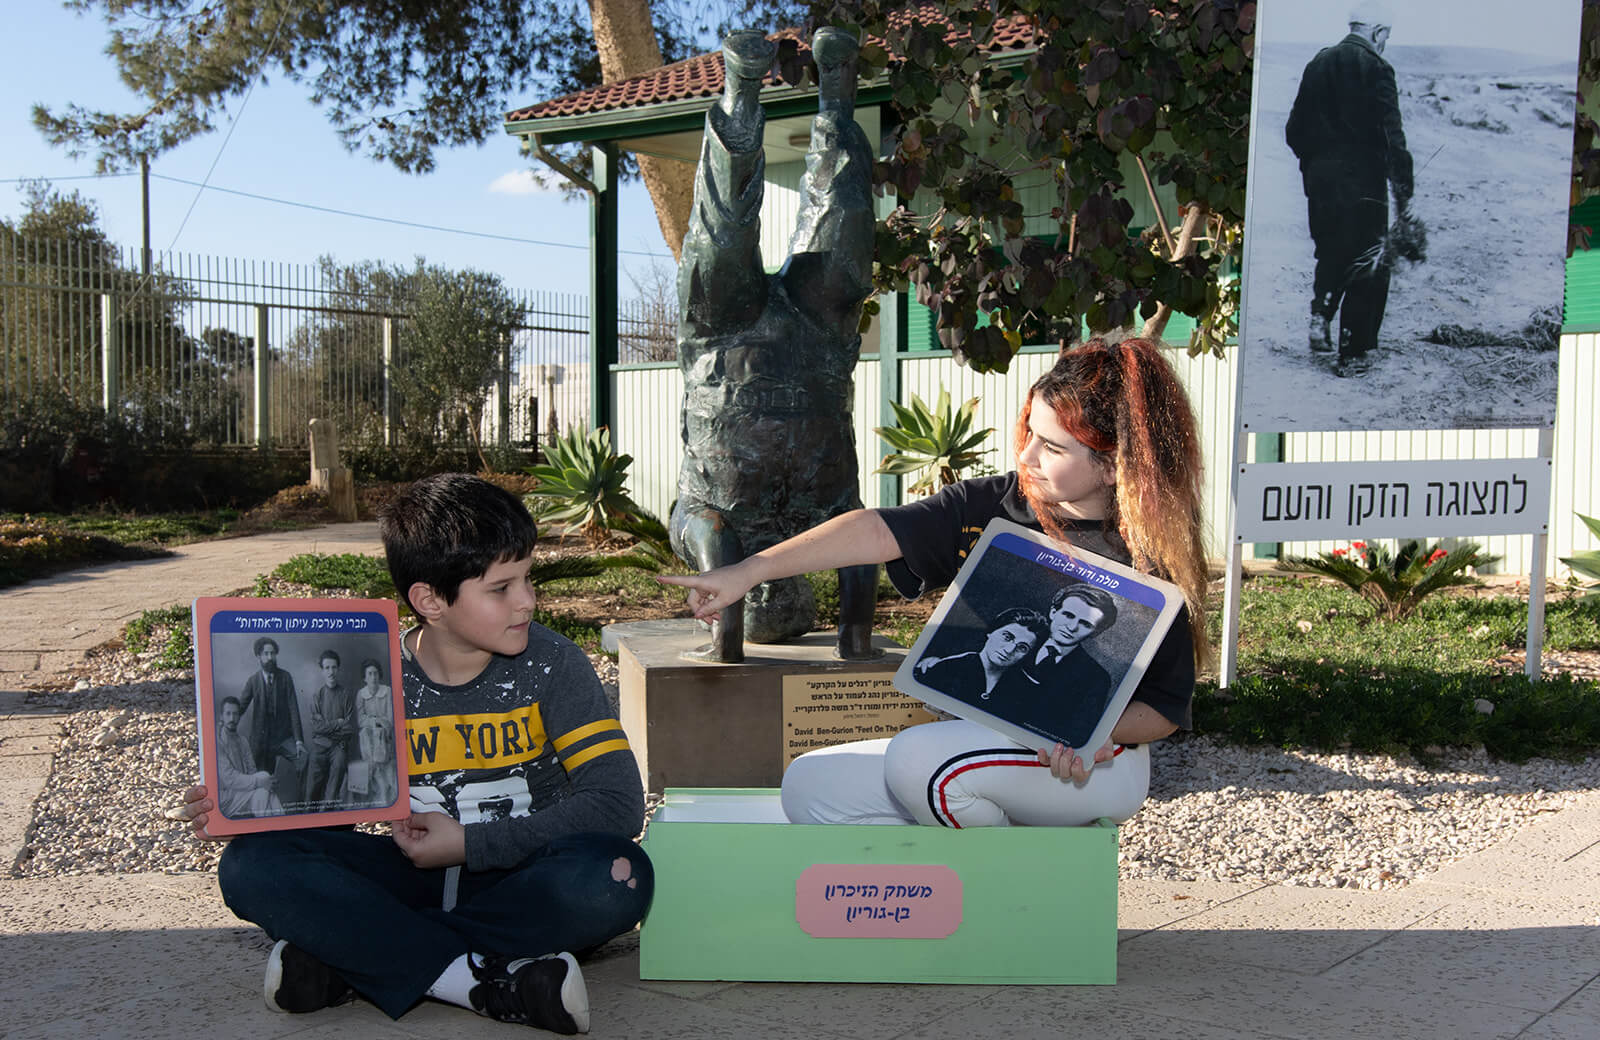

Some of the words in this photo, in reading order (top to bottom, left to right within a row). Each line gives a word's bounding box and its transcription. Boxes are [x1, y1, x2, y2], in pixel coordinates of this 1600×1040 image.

[1426, 474, 1528, 517] לתצוגה
[1262, 485, 1333, 522] והעם
[1348, 482, 1410, 526] הזקן
[1036, 551, 1075, 573] בן-גוריון
[1095, 574, 1120, 589] פולה
[285, 617, 309, 632] עיתון
[311, 617, 344, 629] מערכת
[346, 617, 367, 629] חברי
[837, 679, 847, 688] על
[811, 693, 832, 701] הראש
[833, 692, 843, 700] על
[845, 691, 866, 699] לעמוד
[868, 691, 880, 699] נהג
[794, 727, 813, 736] David
[817, 726, 853, 735] Ben-Gurion
[874, 725, 884, 733] On
[885, 724, 898, 732] The
[789, 740, 808, 748] David
[825, 884, 879, 901] הזיכרון
[883, 885, 933, 901] משחק
[846, 906, 910, 923] בן-גוריון
